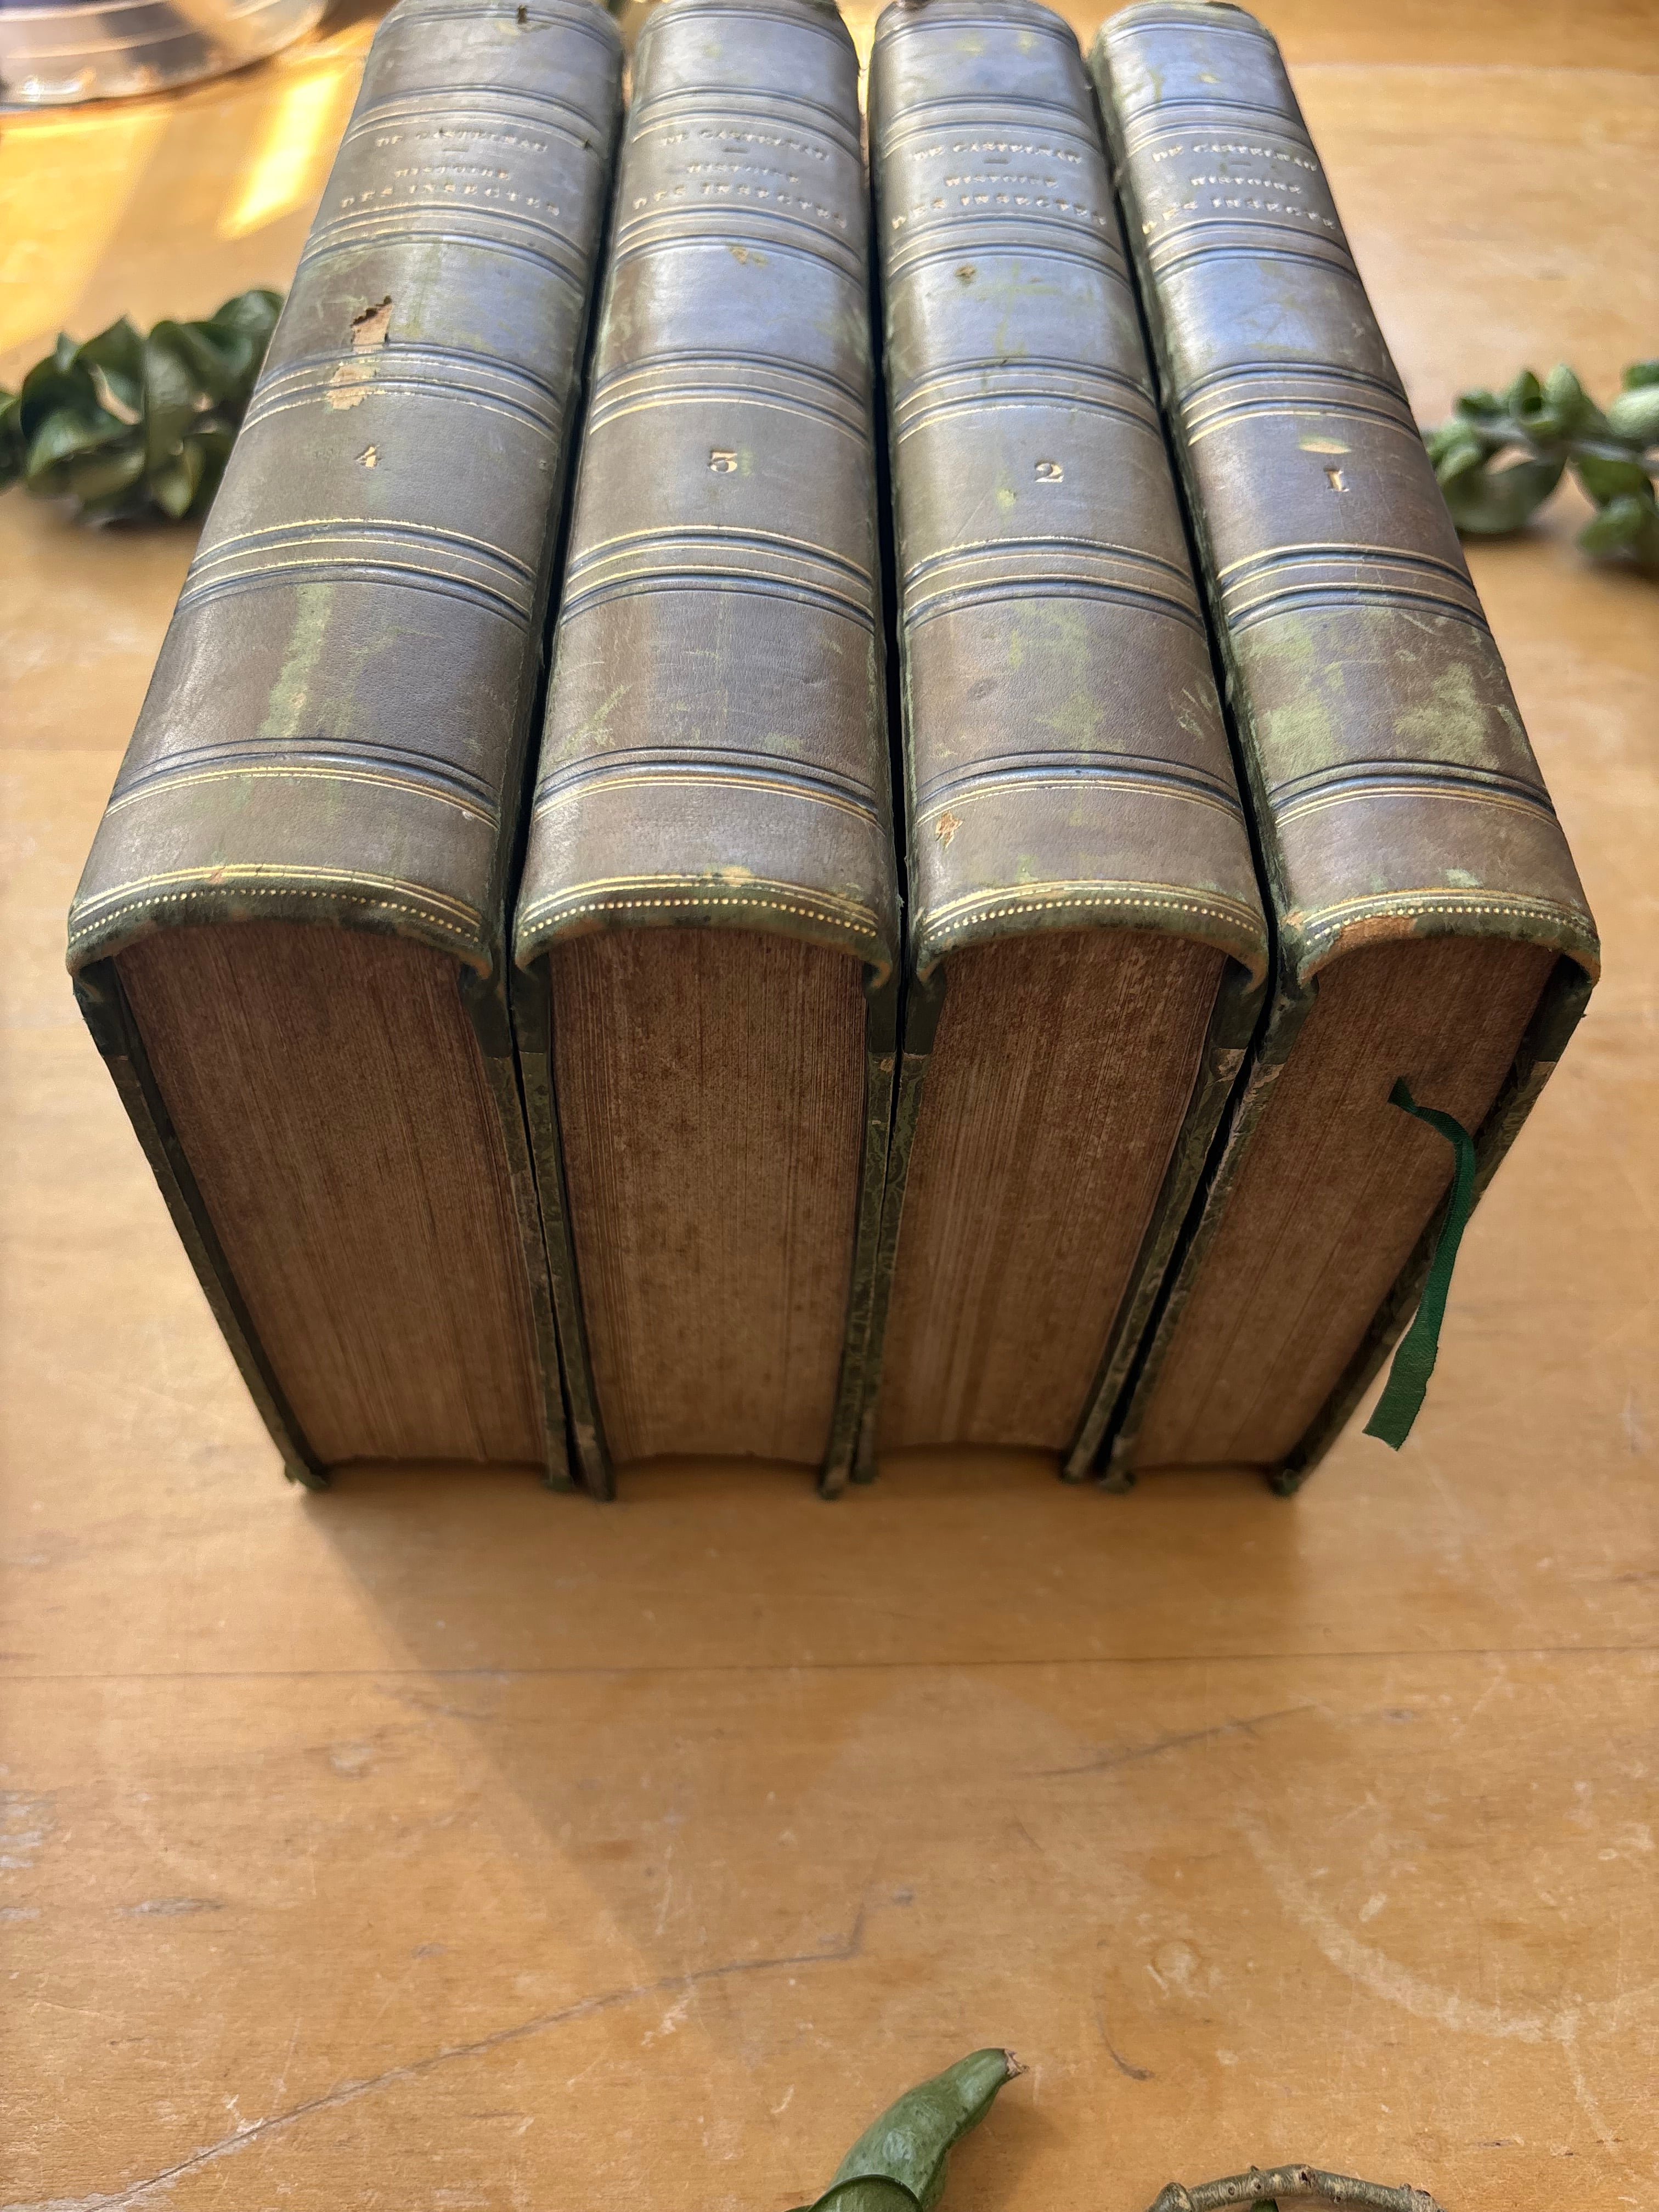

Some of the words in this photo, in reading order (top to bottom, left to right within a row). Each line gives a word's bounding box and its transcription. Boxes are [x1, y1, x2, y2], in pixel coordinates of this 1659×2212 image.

[353, 443, 382, 469] 4
[1035, 459, 1064, 483] 2
[1323, 465, 1350, 492] 1
